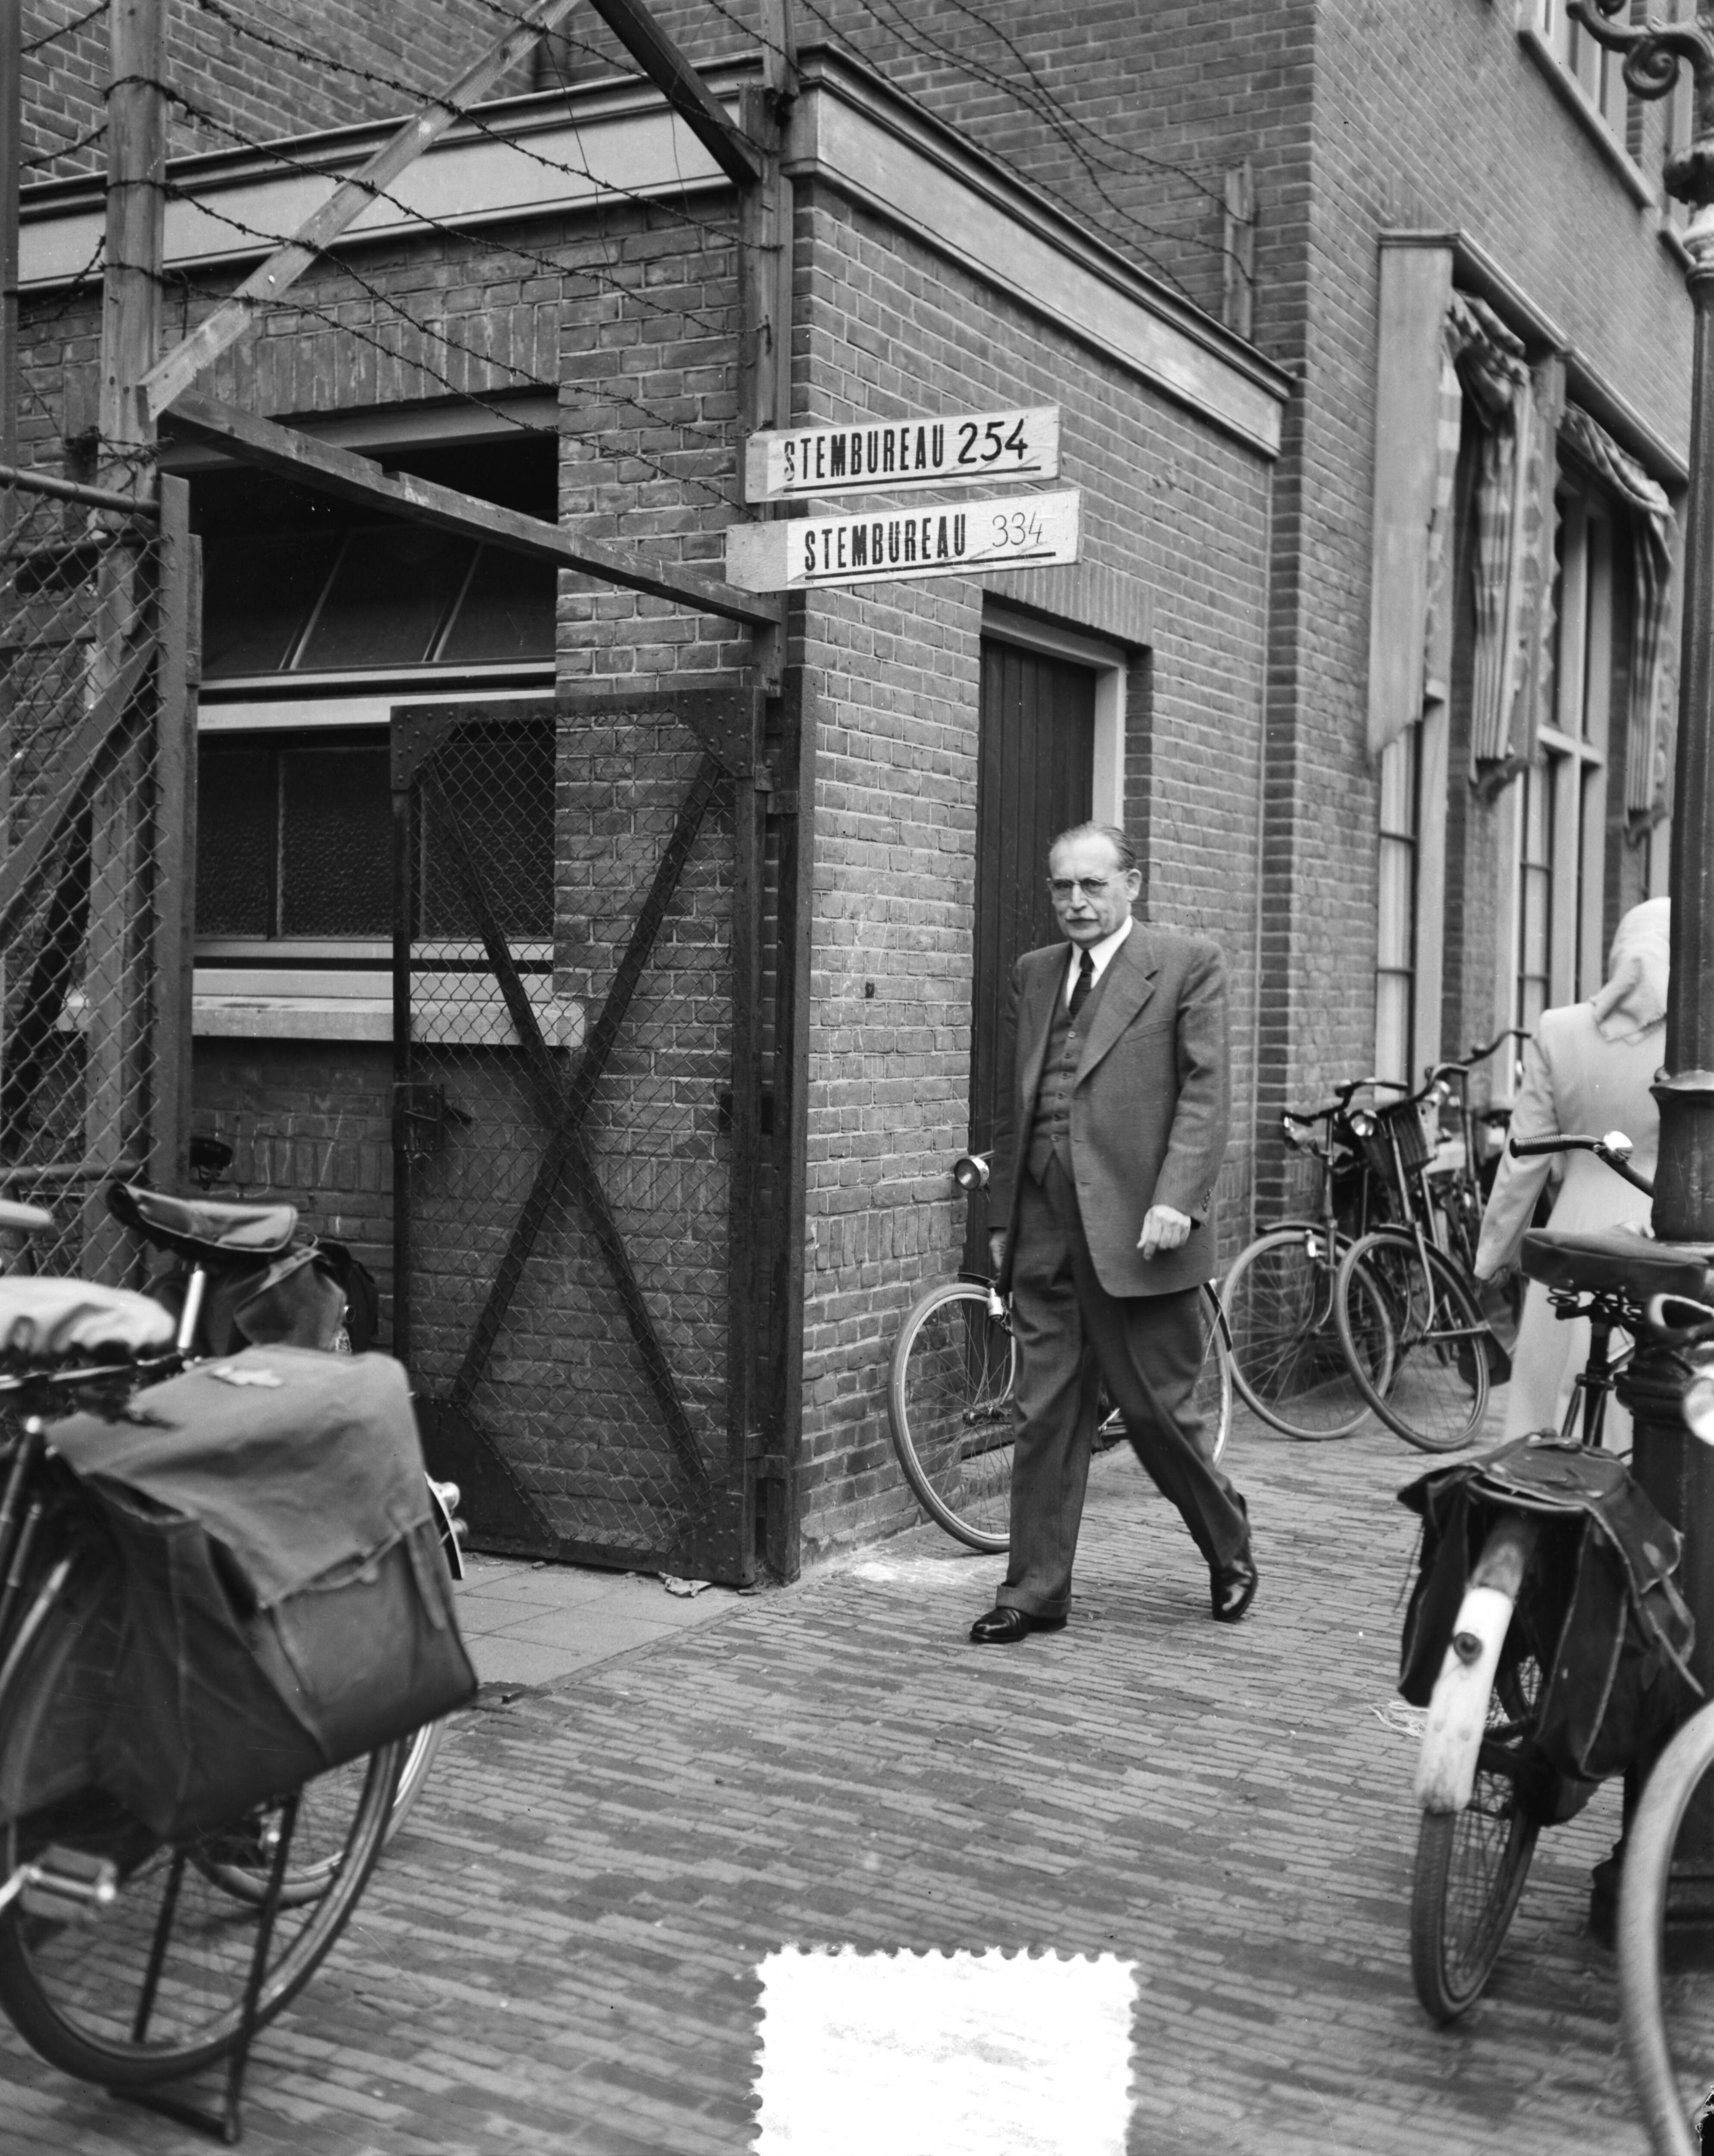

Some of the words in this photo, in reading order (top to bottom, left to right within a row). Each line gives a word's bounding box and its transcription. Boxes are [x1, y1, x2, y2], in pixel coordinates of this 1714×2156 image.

[783, 424, 944, 481] STEMBUREAU
[957, 418, 1028, 464] 254
[804, 514, 966, 572] STEMBUREAU
[992, 511, 1043, 548] 334
